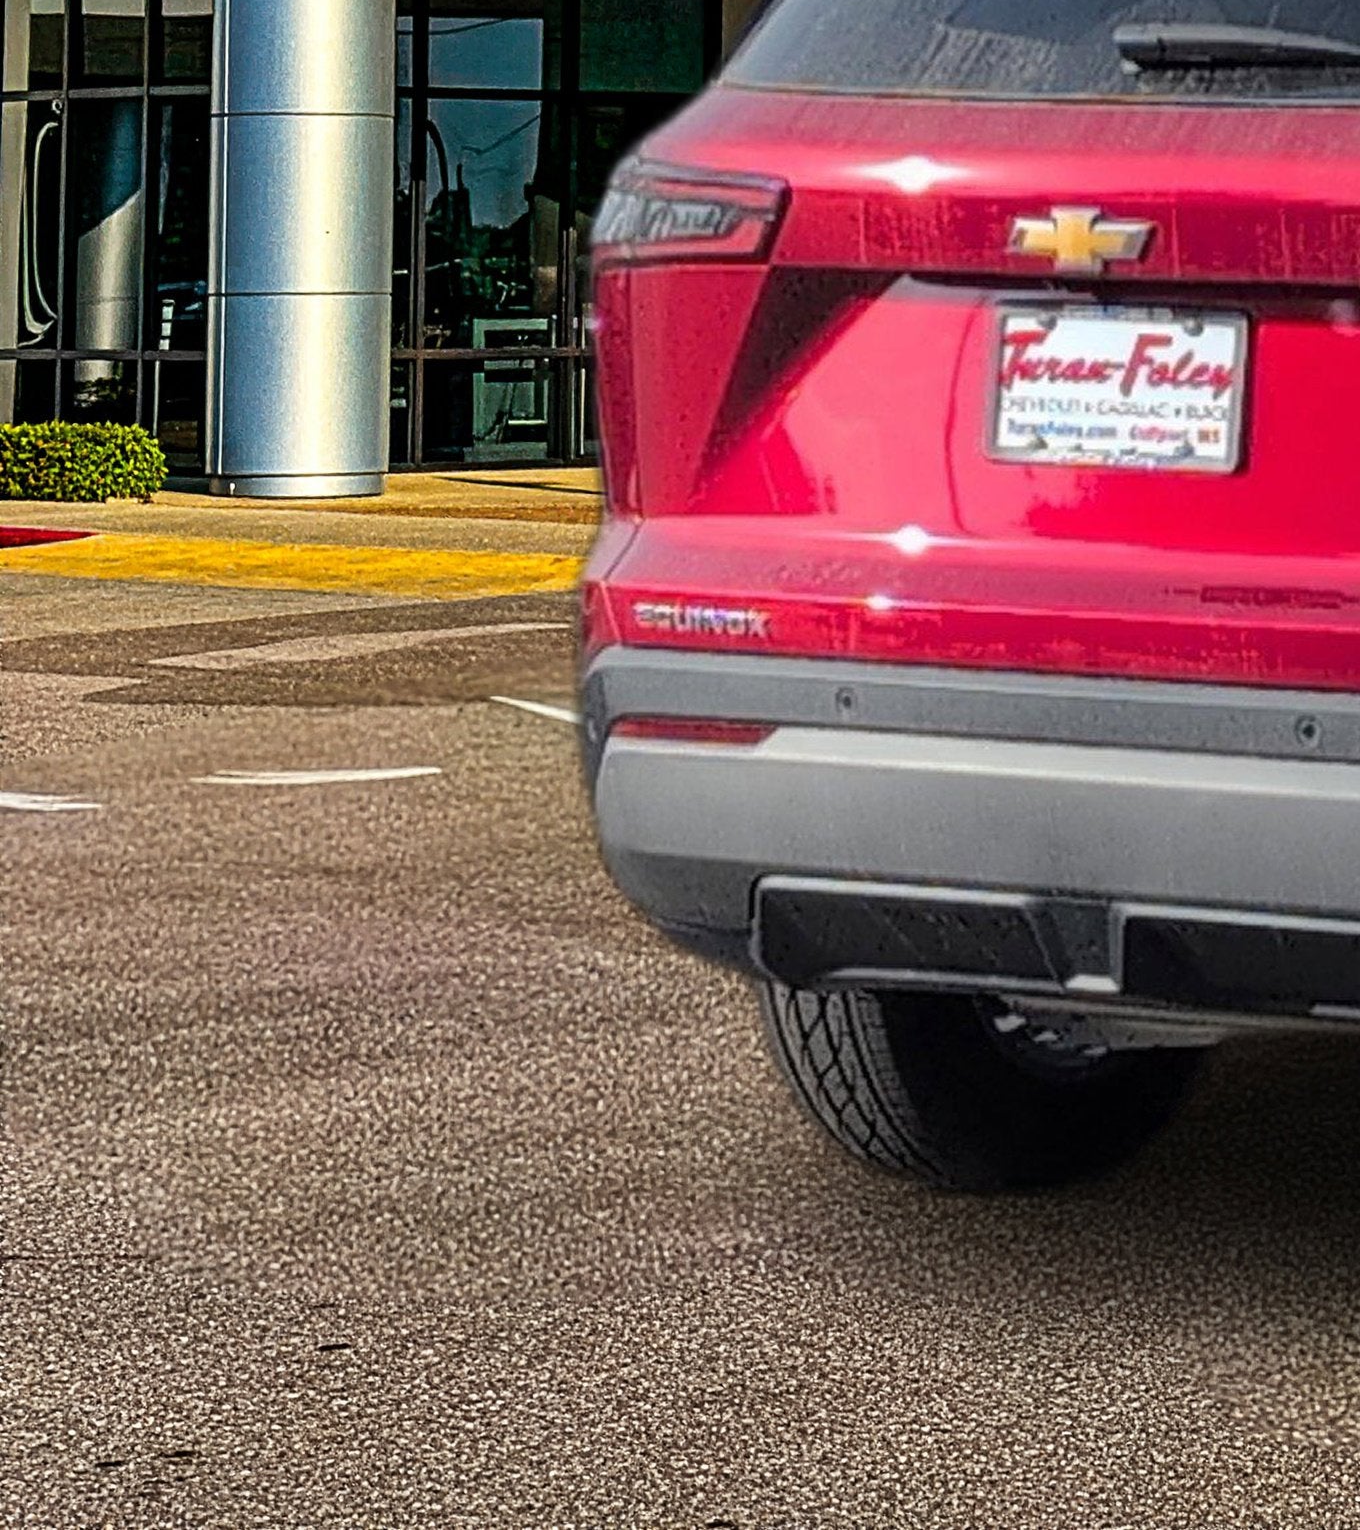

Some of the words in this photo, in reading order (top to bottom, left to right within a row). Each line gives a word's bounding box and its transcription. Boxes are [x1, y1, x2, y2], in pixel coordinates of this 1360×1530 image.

[1000, 329, 1124, 390] Turan
[1119, 333, 1233, 400] Foley
[633, 602, 770, 638] EQUINOX
